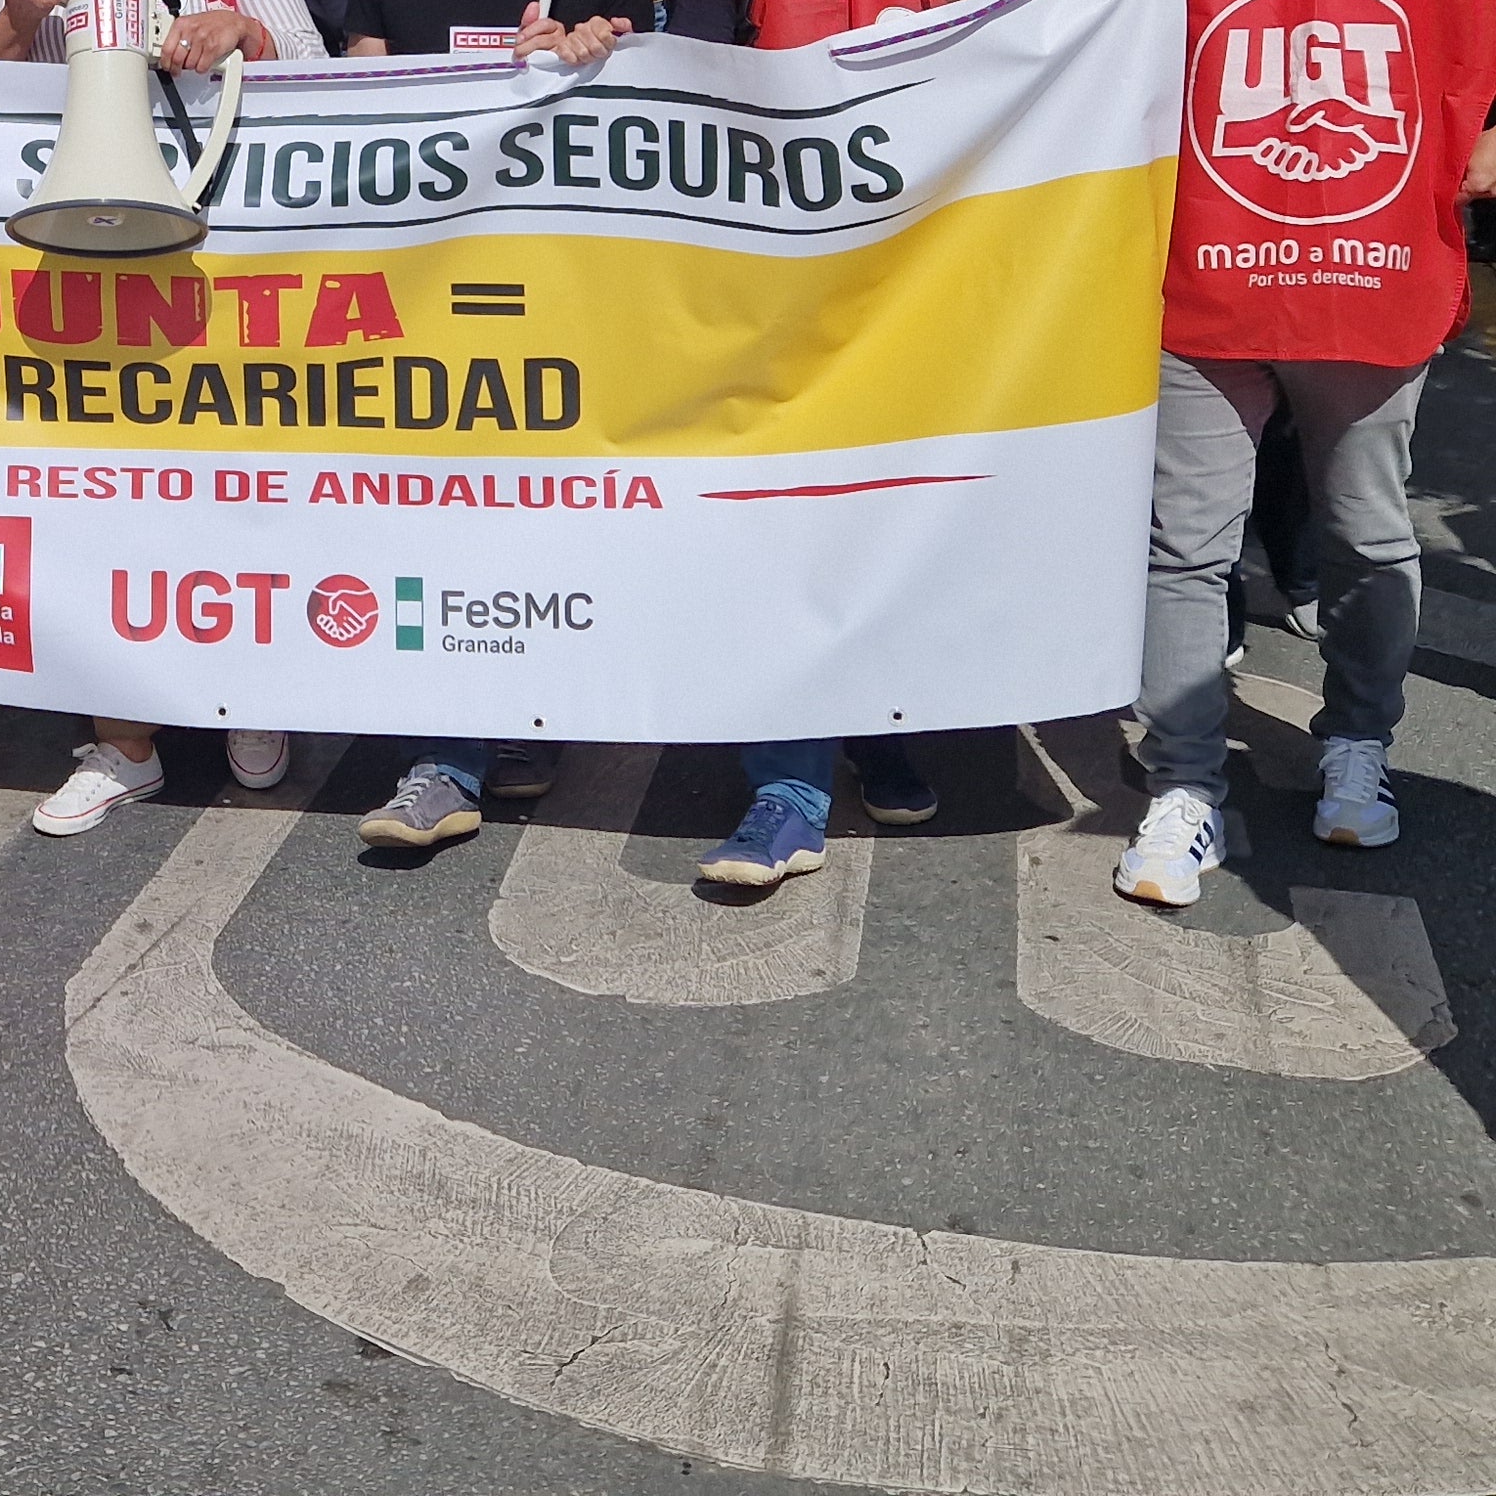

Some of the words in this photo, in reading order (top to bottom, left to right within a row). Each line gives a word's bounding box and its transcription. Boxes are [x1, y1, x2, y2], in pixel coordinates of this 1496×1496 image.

[455, 34, 501, 46] CCOO
[1219, 20, 1403, 116] UGT
[495, 114, 904, 212] SEGUROS
[1197, 239, 1299, 272] mano
[1309, 247, 1322, 263] a
[1332, 237, 1410, 272] mano
[1248, 270, 1274, 290] Por
[1278, 269, 1307, 287] tus
[1312, 268, 1382, 291] derechos
[7, 465, 193, 502] RESTO
[213, 470, 287, 505] DE
[309, 468, 664, 510] ANDALUCÍA
[111, 570, 290, 644] UGT
[440, 590, 594, 632] FeSMC
[442, 634, 526, 655] Granada
